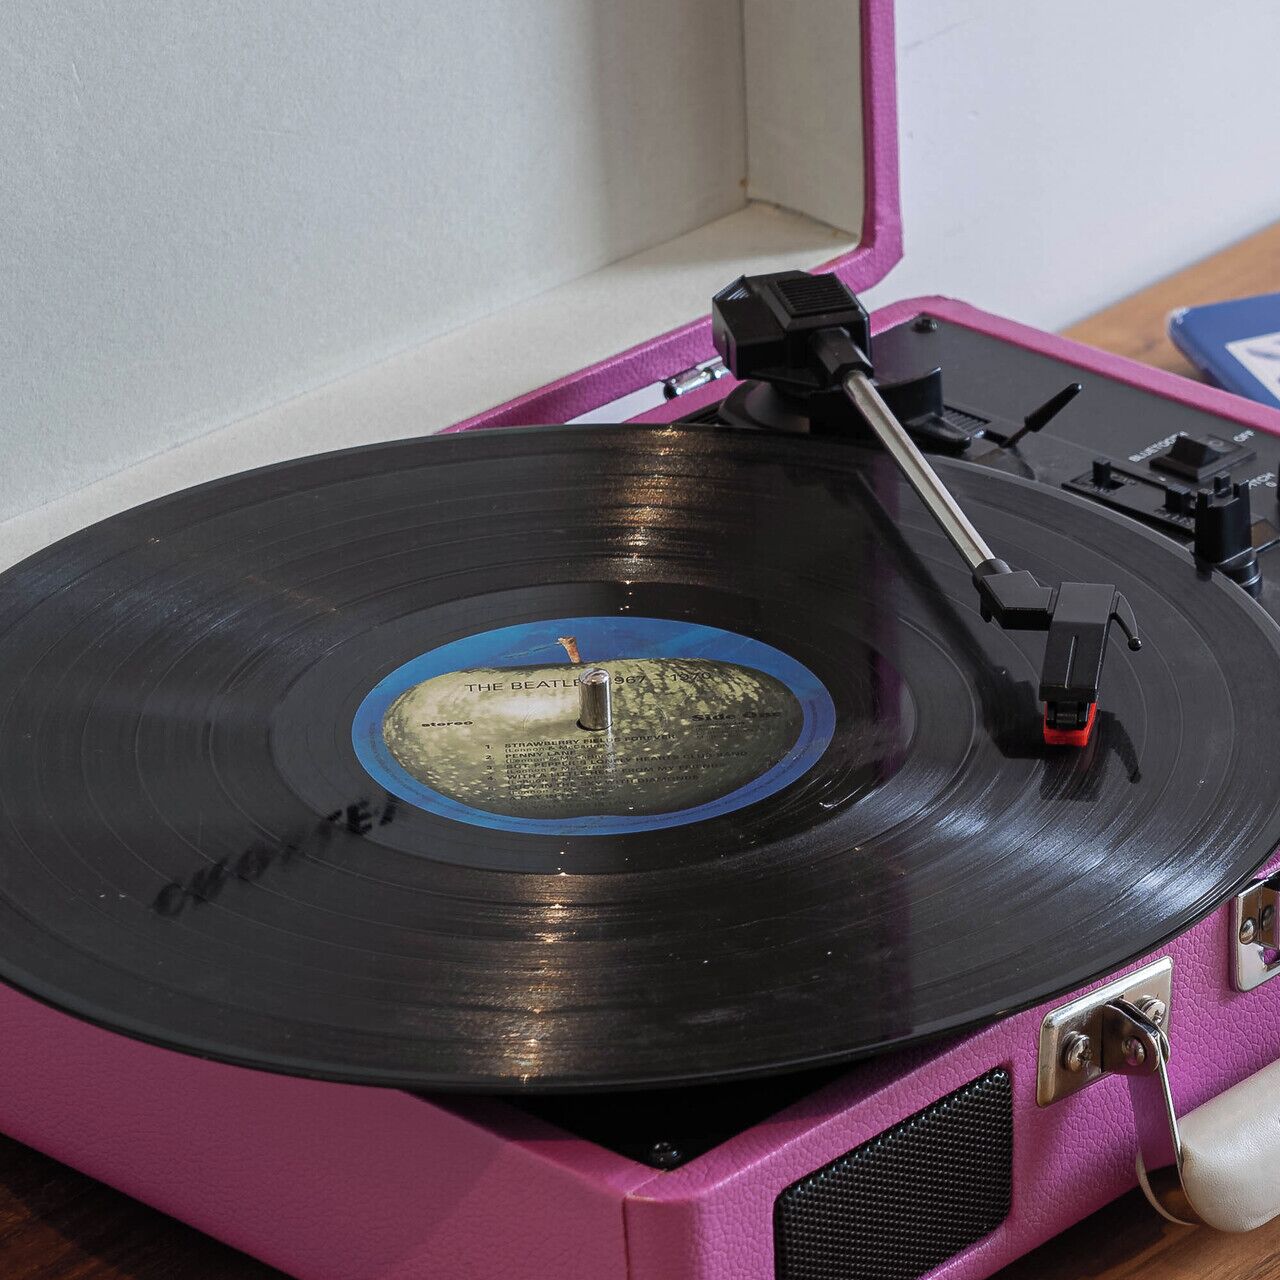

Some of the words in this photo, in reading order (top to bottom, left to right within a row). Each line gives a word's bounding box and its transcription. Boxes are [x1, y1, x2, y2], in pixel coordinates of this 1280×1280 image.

[465, 682, 503, 692] THE
[511, 678, 580, 691] BEATLE
[613, 675, 647, 685] 967
[671, 672, 712, 682] 1970
[504, 739, 579, 748] STRAWBERRY
